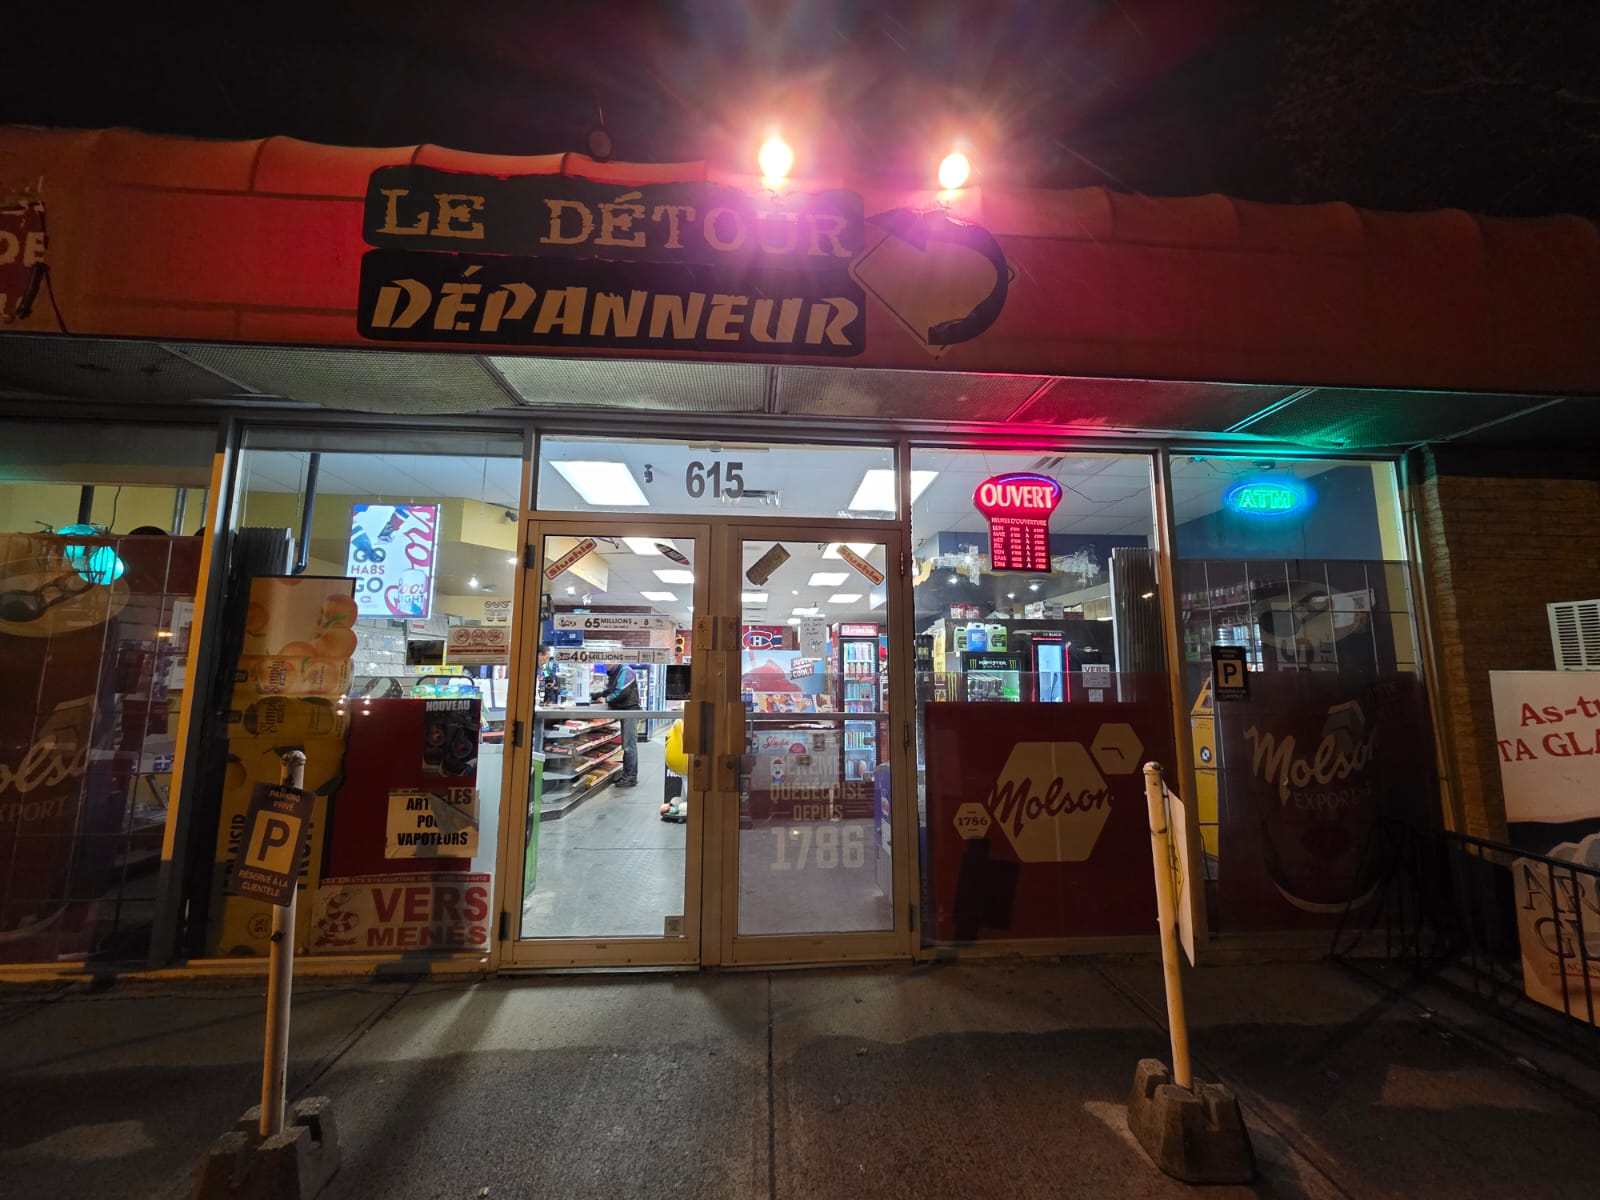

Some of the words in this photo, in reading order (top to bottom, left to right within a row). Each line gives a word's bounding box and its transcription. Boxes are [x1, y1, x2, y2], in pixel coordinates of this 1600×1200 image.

[375, 188, 485, 240] LE
[540, 191, 853, 258] DÉTOUR
[371, 265, 858, 346] DÉPANNEUR
[686, 461, 744, 498] 615
[981, 484, 1053, 509] OUVERT
[1240, 490, 1290, 508] ATM
[353, 548, 386, 563] GO
[351, 565, 385, 575] HABS
[585, 618, 600, 628] 65
[571, 651, 588, 661] 40
[1223, 663, 1237, 684] P
[426, 700, 471, 712] NOUVEAU
[1496, 738, 1538, 762] TA
[269, 790, 302, 803] PARKING
[273, 801, 295, 812] PRIVÉ
[793, 804, 844, 821] DEPUIS
[987, 776, 1115, 838] Molson
[958, 816, 988, 826] 1786
[258, 819, 290, 861] P
[397, 832, 468, 846] VAPOTEURS
[771, 825, 865, 870] 1786
[372, 887, 488, 923] VERS
